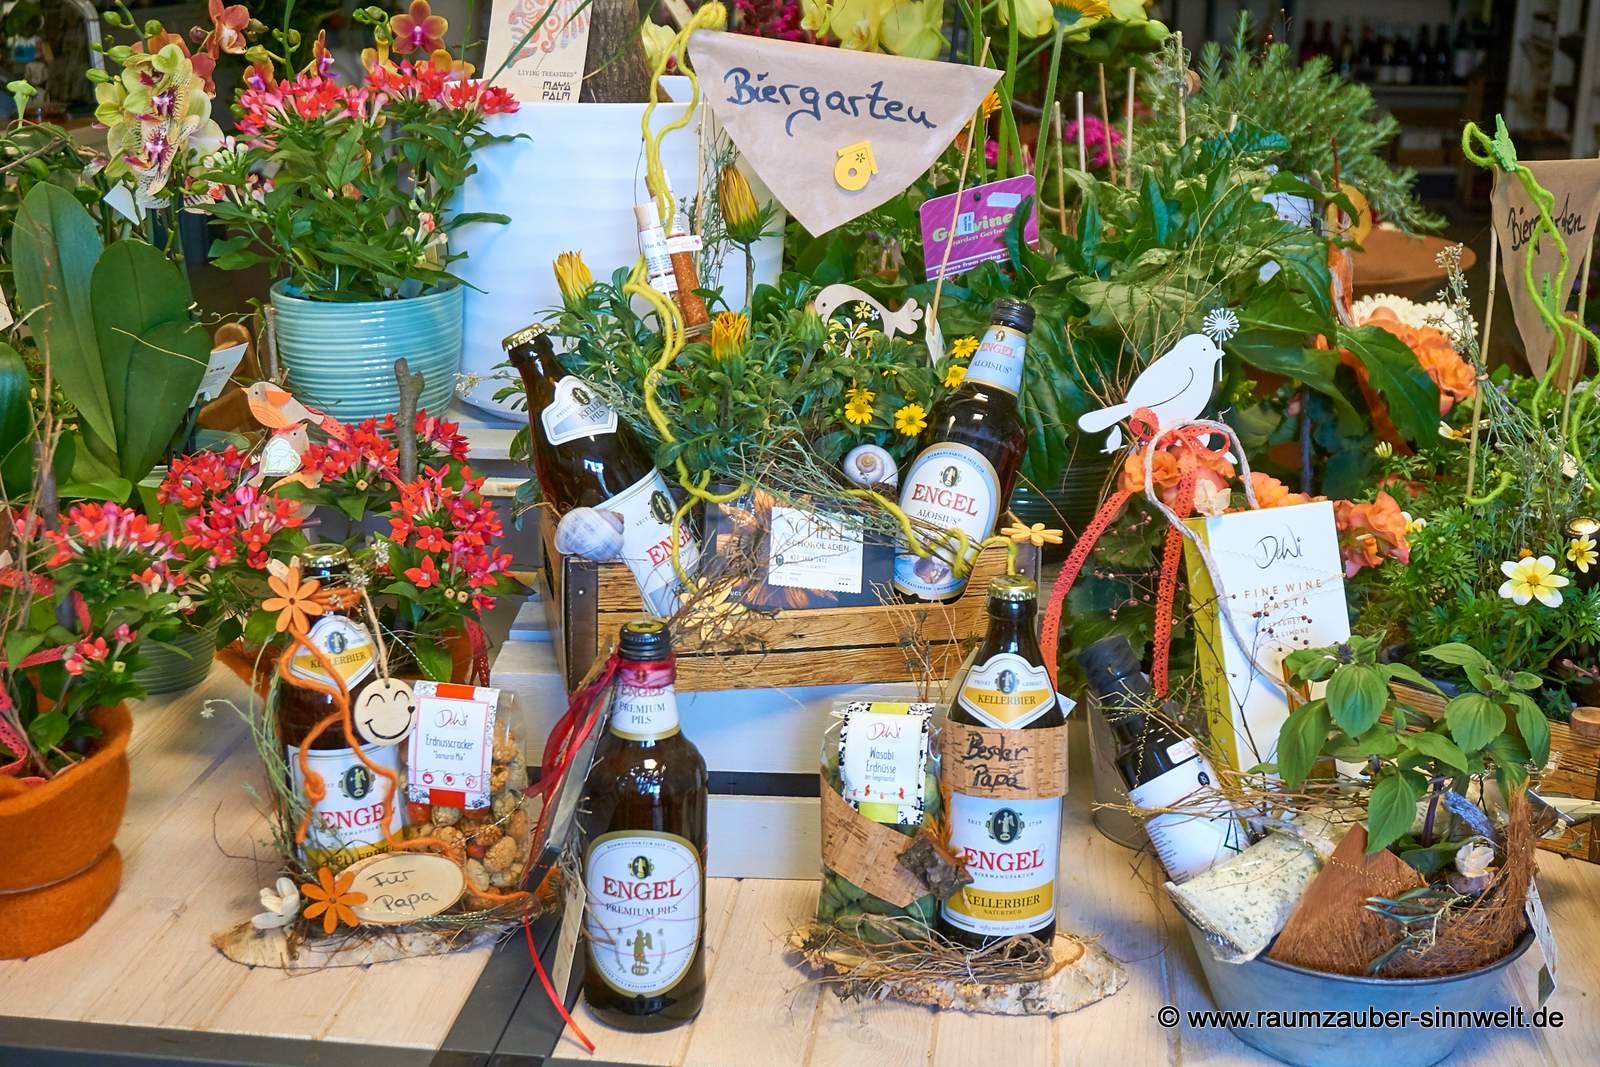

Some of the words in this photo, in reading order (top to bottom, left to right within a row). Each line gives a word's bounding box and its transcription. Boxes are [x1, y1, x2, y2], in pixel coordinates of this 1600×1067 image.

[517, 69, 540, 77] LIVING
[542, 80, 571, 90] MAYA
[541, 91, 571, 101] PALM
[723, 66, 937, 137] Biergarten
[979, 341, 1015, 359] ENGEL
[911, 483, 979, 517] ENGEL
[1244, 585, 1279, 600] FINE
[1285, 579, 1323, 593] WINE
[1263, 598, 1310, 611] PASTA
[977, 694, 1037, 705] KELLERBIER
[618, 701, 665, 714] PREMIUM
[631, 714, 652, 725] PILS
[869, 746, 895, 760] Wasabi
[865, 760, 897, 775] Erdnüsse
[972, 763, 1029, 793] Papa
[963, 846, 1045, 872] ENGEL
[602, 874, 682, 901] ENGEL
[372, 891, 439, 912] Papa
[605, 902, 656, 918] PREMIUM
[656, 902, 678, 916] PILS
